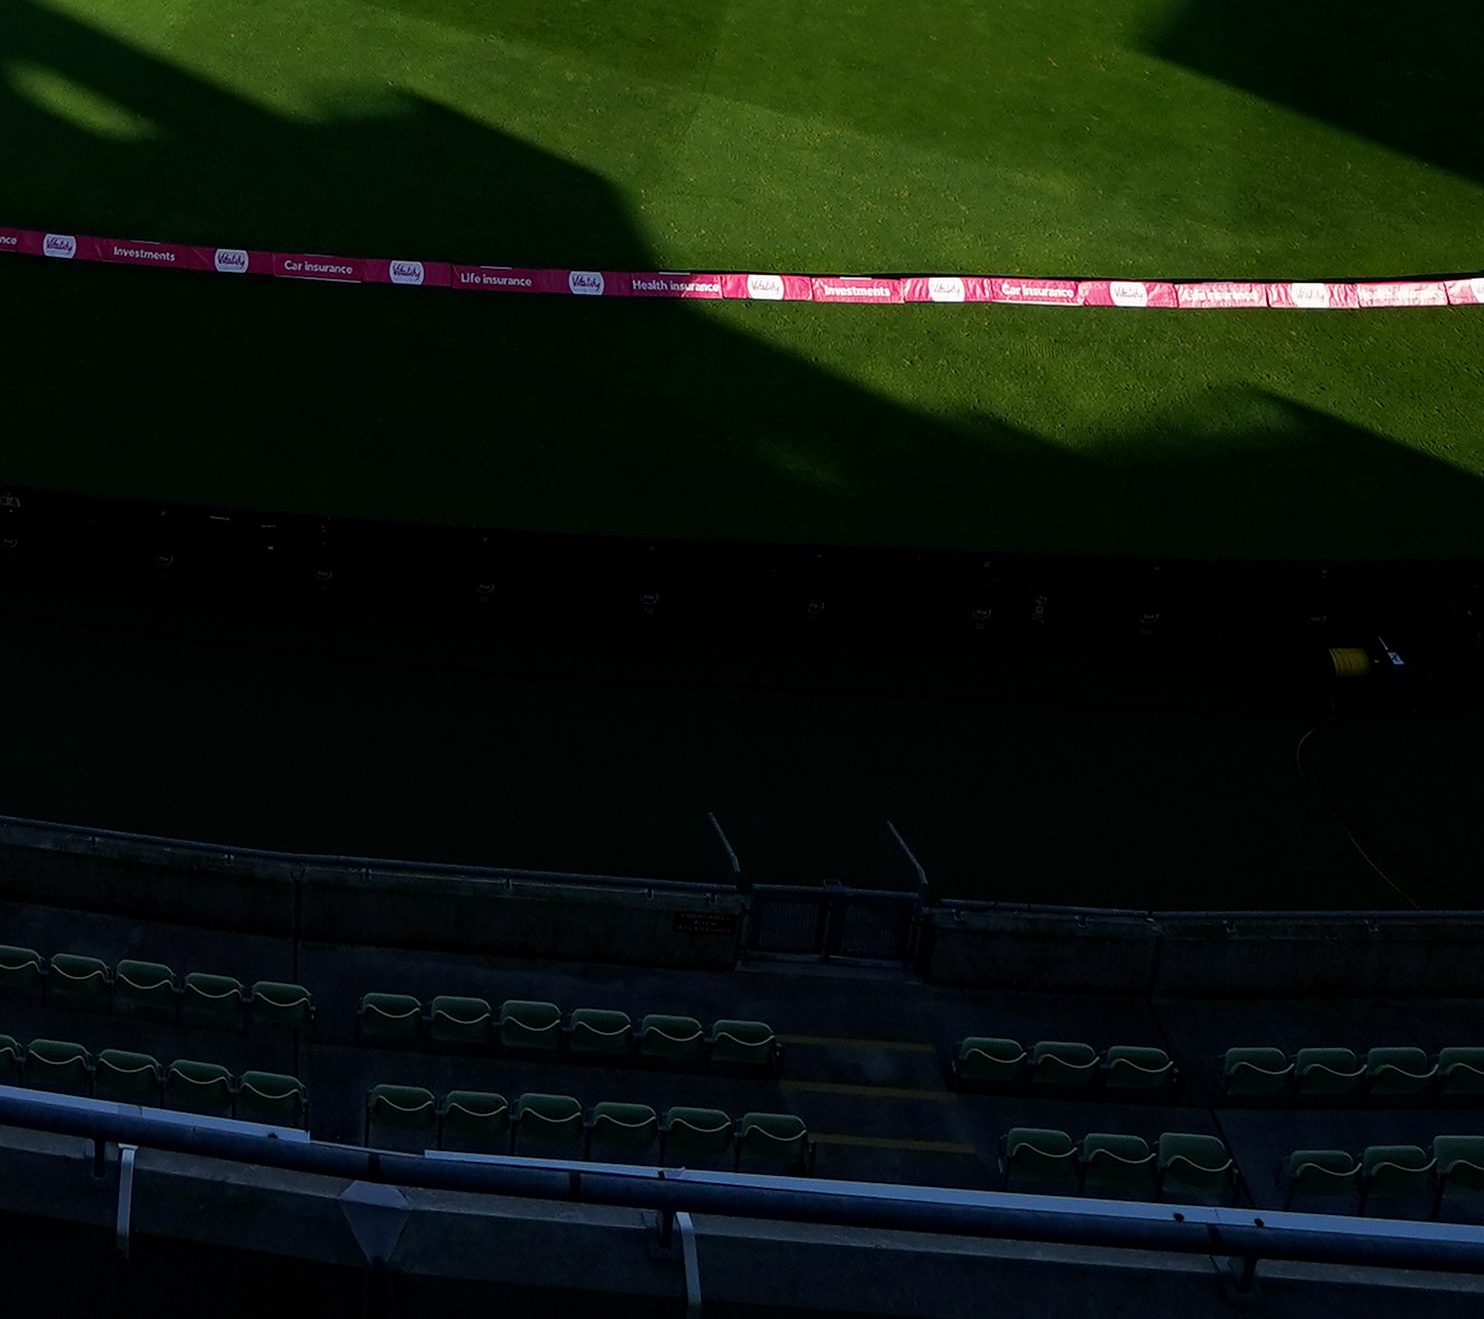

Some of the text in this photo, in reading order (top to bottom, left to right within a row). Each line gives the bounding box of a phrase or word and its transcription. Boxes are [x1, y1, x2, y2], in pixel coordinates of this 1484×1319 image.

[113, 246, 175, 262] Investments
[284, 260, 353, 275] Car insurance
[461, 272, 532, 287] Life insurance
[632, 279, 719, 293] Health insurance
[824, 284, 890, 297] Investments
